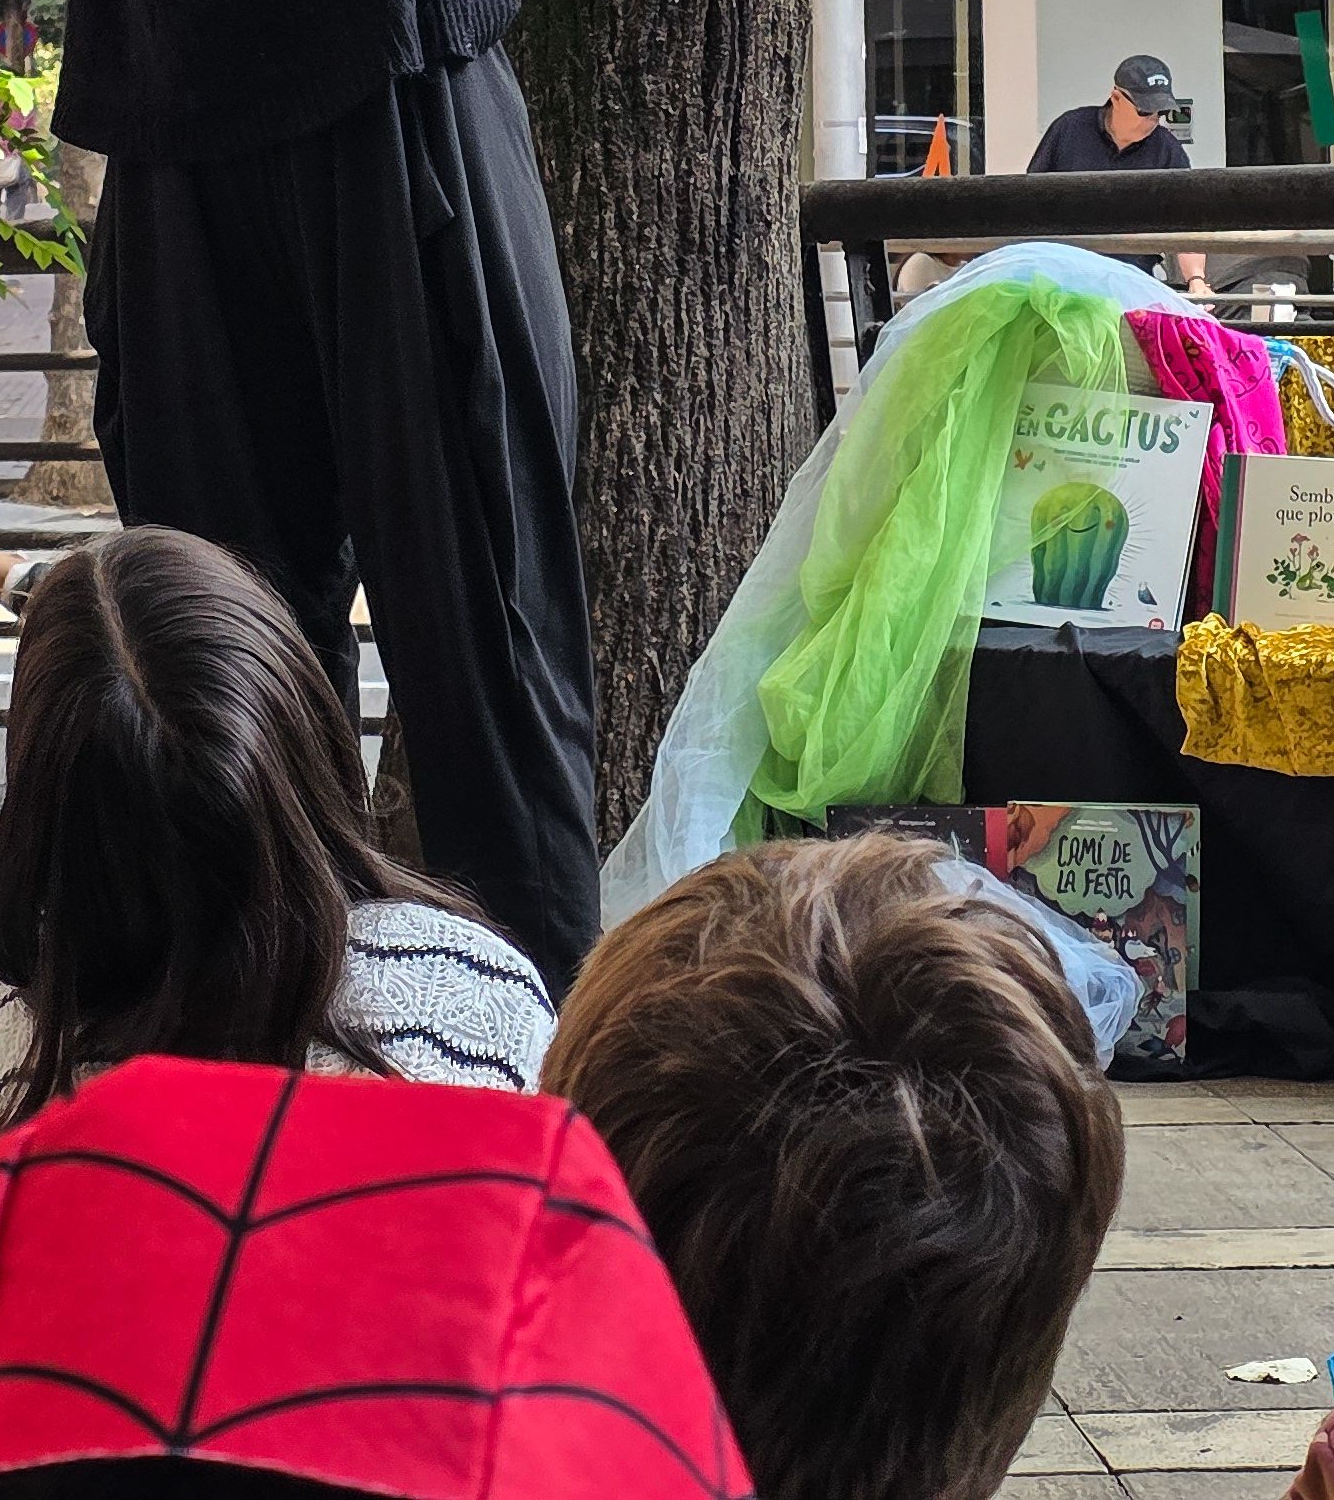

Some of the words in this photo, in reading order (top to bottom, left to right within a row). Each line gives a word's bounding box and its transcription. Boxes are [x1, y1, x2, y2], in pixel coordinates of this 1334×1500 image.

[1045, 403, 1182, 454] CACTUS
[1276, 509, 1304, 525] que
[1057, 834, 1105, 867] CAMÍ
[1111, 840, 1132, 865] DE
[1056, 870, 1076, 894] LA
[1083, 868, 1134, 900] FESTA
